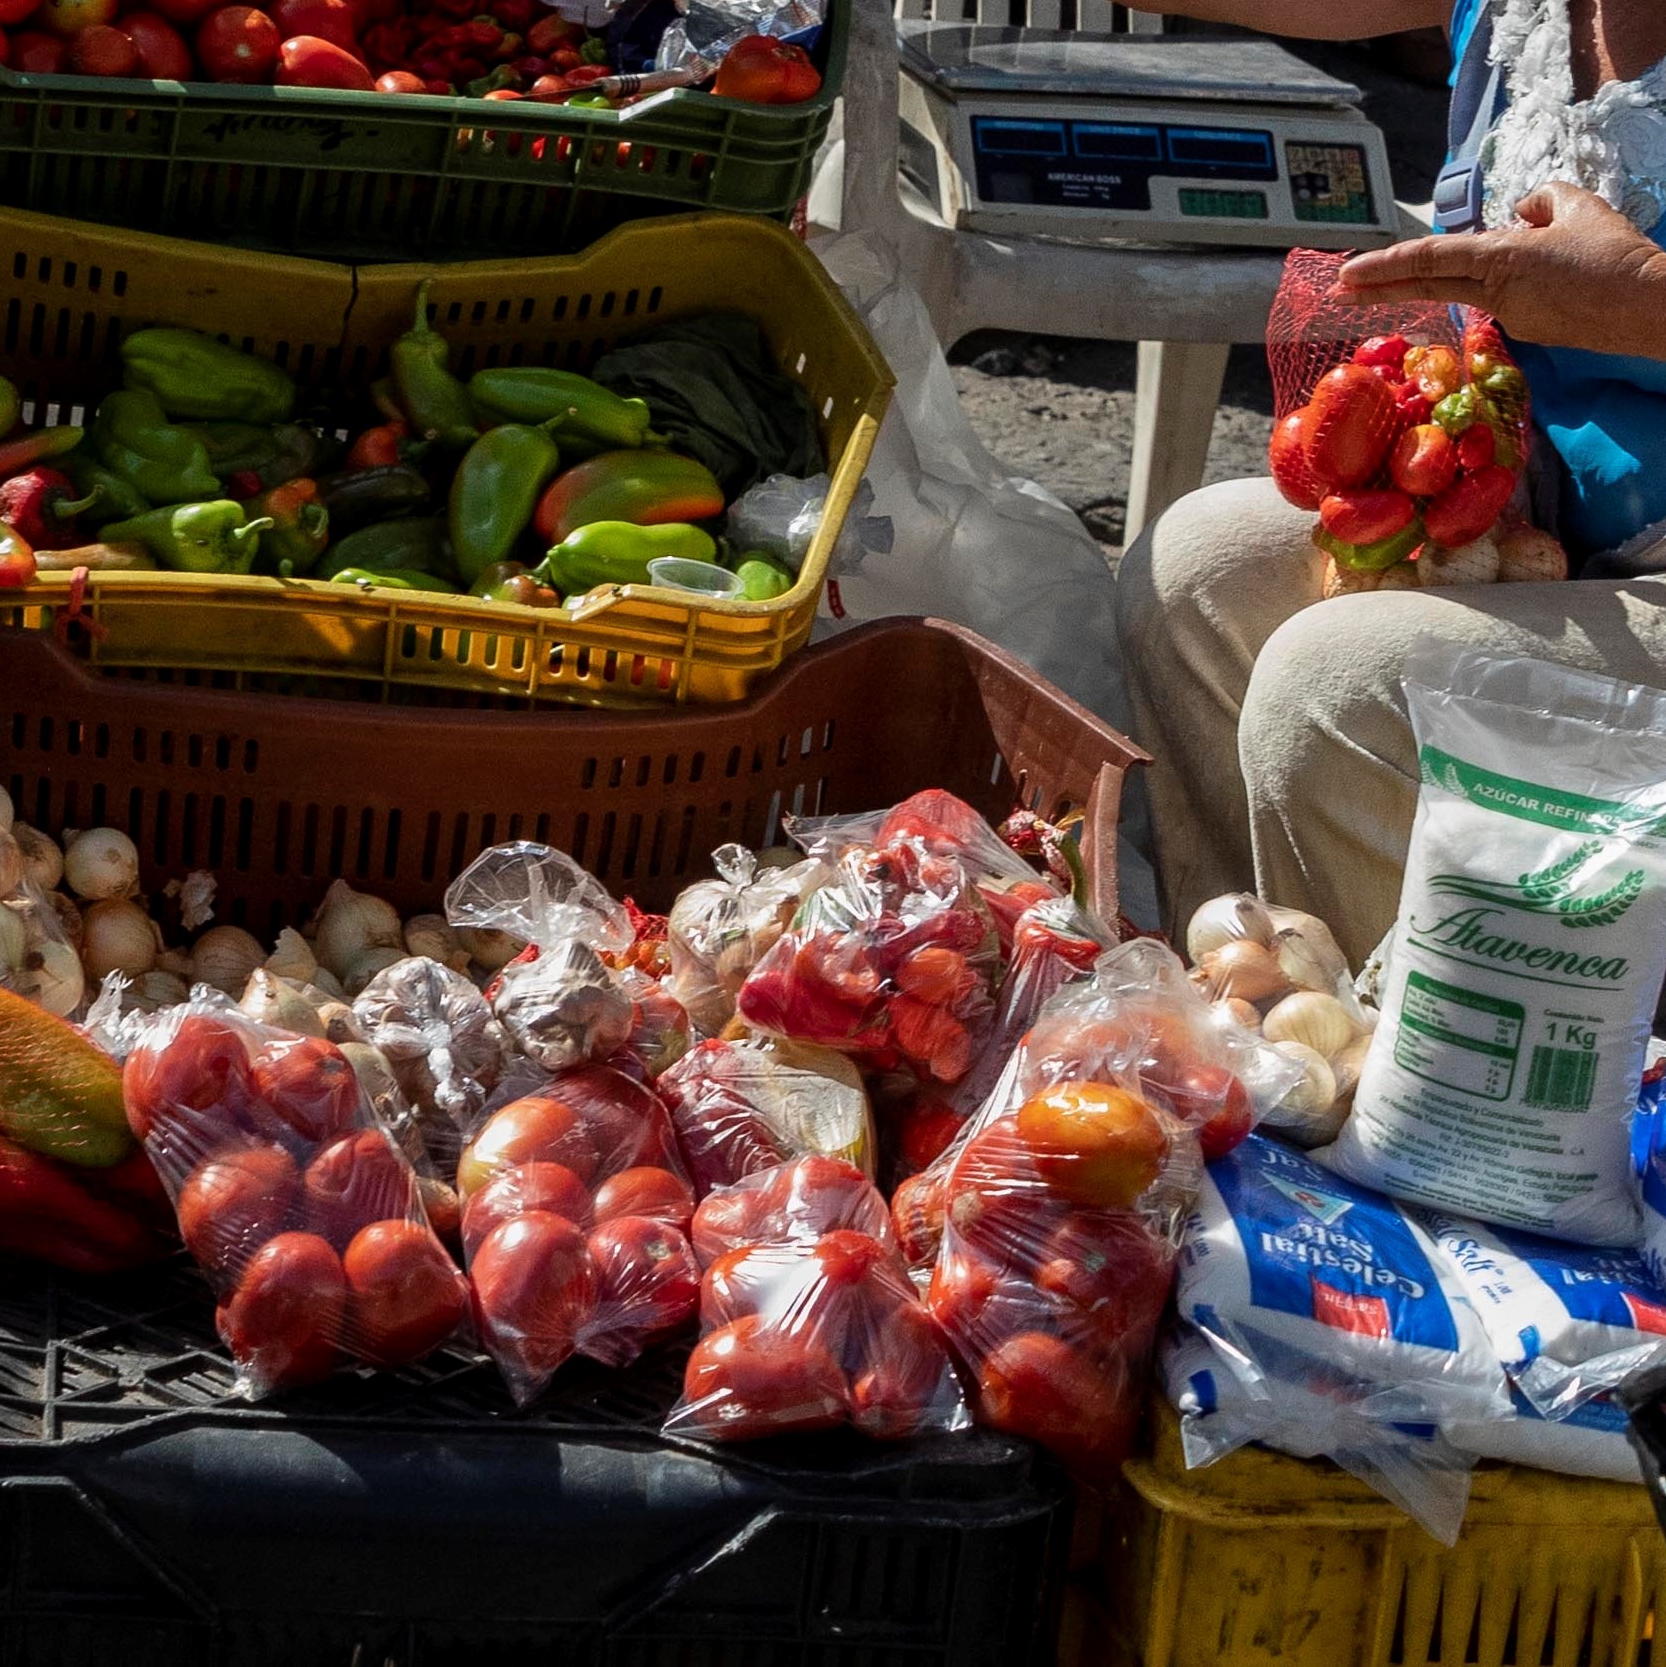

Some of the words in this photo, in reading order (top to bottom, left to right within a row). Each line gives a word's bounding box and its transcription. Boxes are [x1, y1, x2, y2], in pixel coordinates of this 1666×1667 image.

[1047, 172, 1095, 183] AMERICAN
[1473, 782, 1539, 811] AZÚCAR
[1410, 907, 1631, 980] Atavenca
[1546, 1022, 1557, 1041] 1
[1565, 1024, 1597, 1050] Kg
[1297, 1223, 1374, 1263] Salt
[1448, 1237, 1494, 1277] Salt
[1261, 1232, 1425, 1298] Celestial
